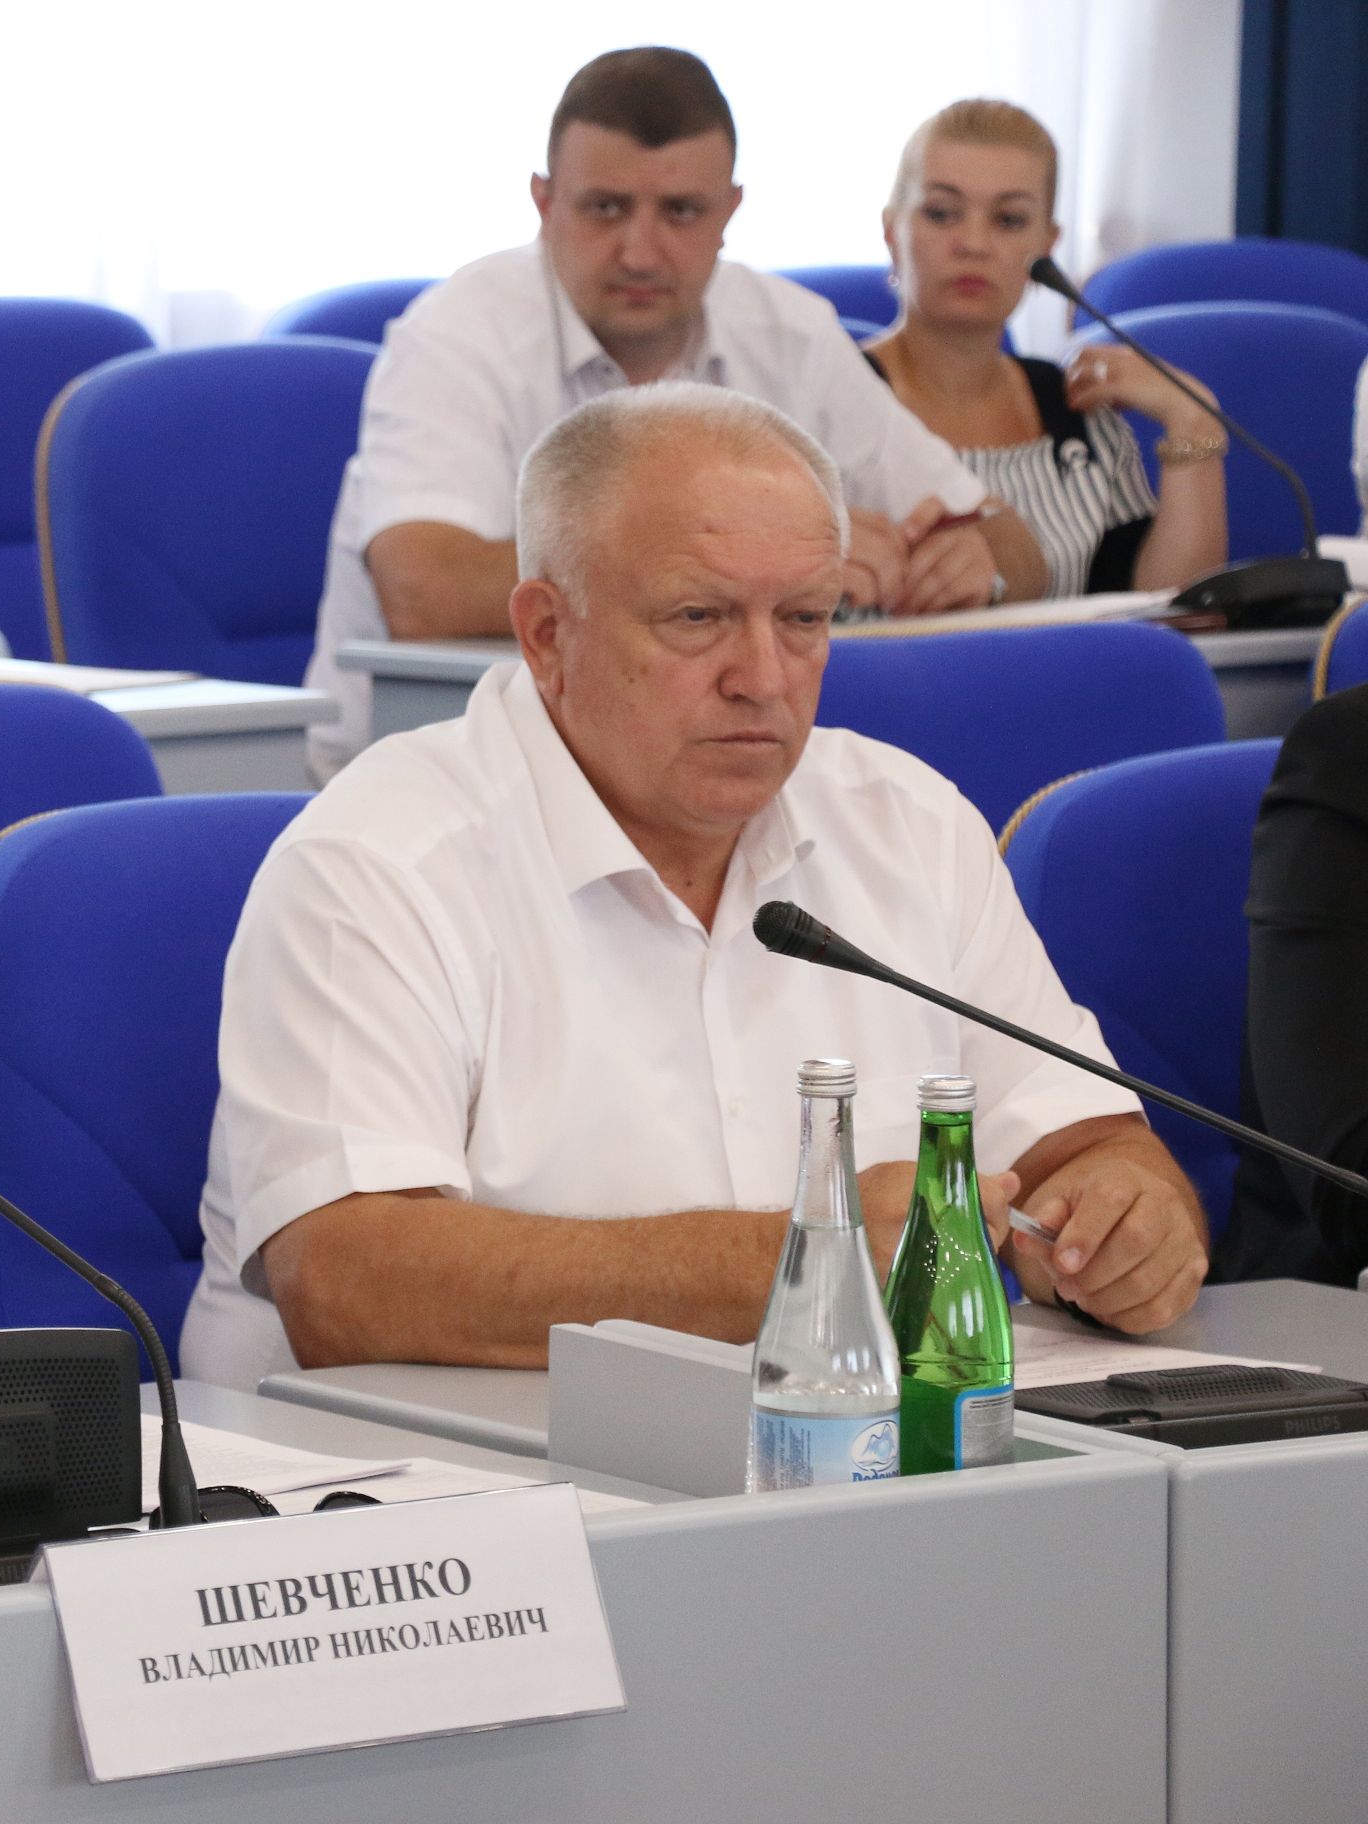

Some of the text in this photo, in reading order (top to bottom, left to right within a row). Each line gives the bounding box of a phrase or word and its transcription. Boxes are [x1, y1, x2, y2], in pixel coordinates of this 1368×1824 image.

[1284, 1415, 1341, 1435] PHILIPS
[195, 1557, 472, 1627] ШЕВЧЕНКО
[138, 1607, 550, 1685] ВЛАДИМИР НИКОЛАЕВИЧ
